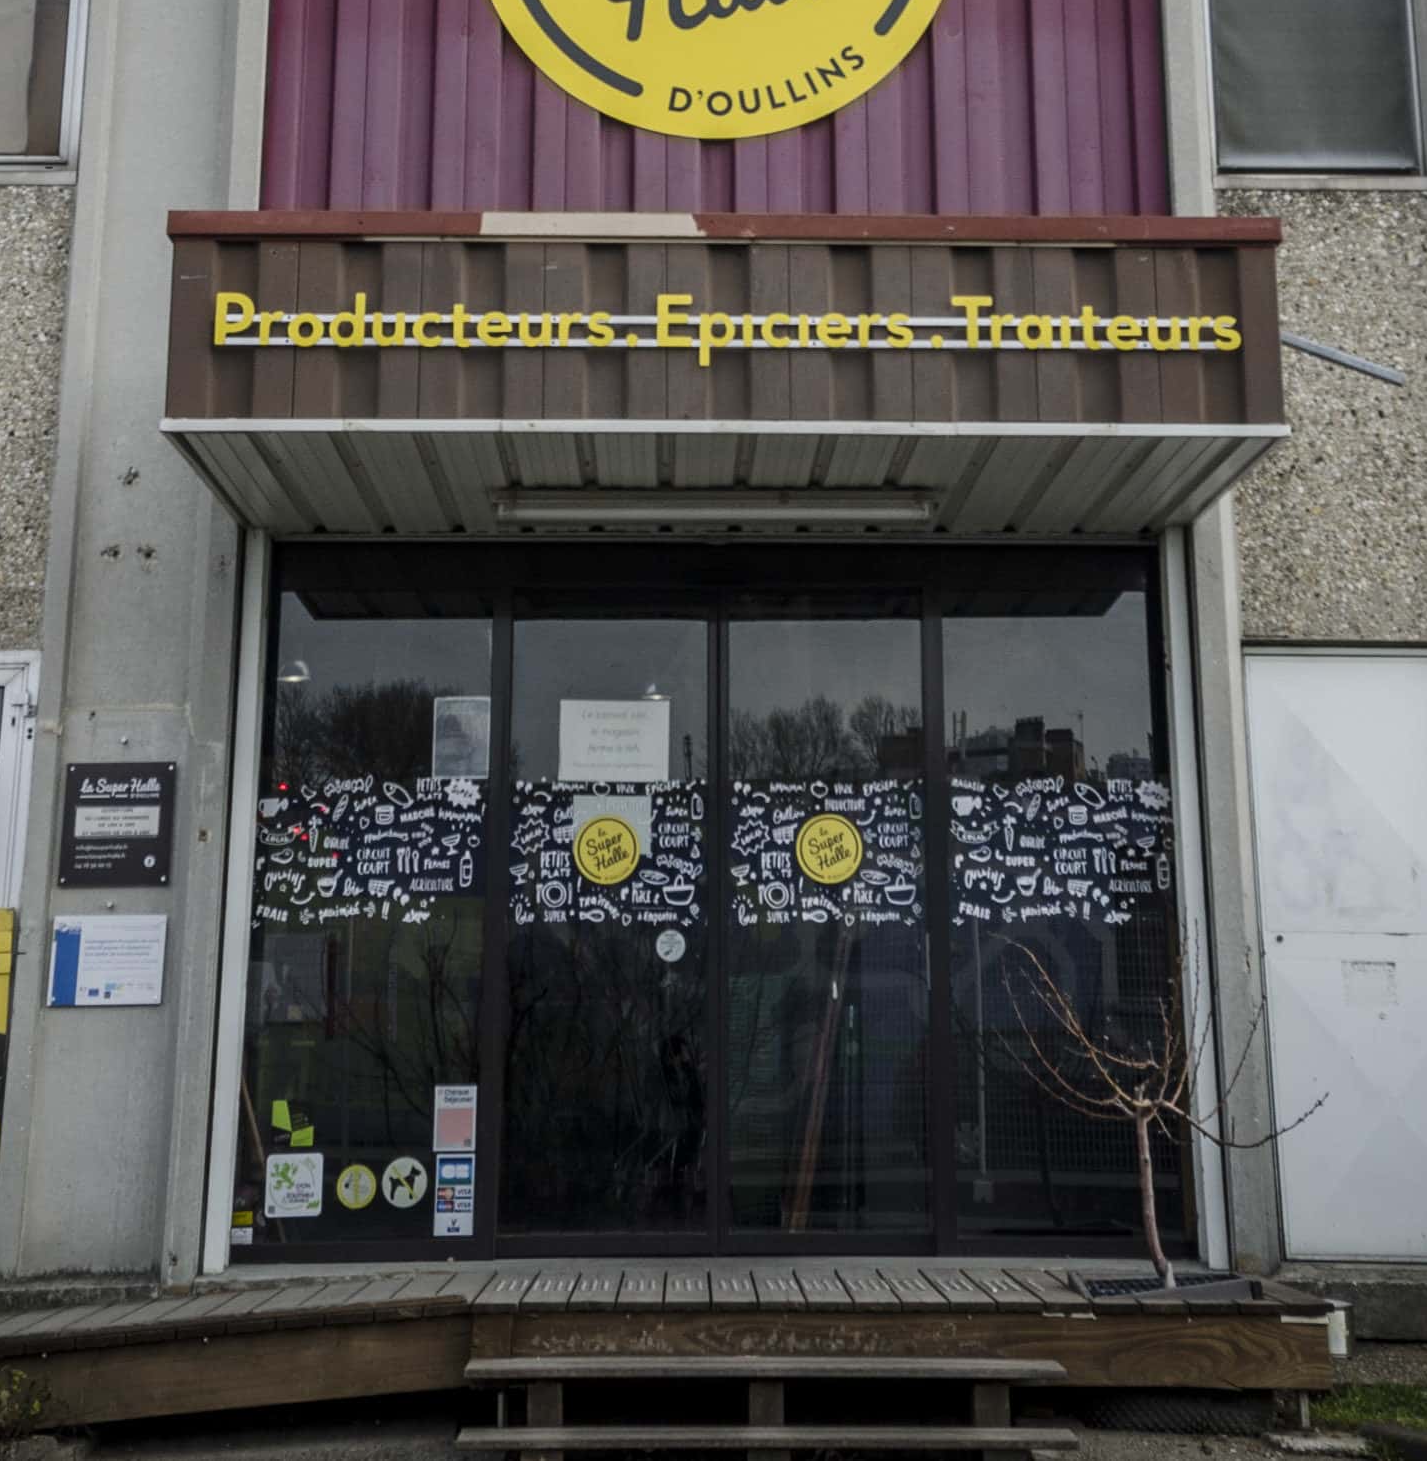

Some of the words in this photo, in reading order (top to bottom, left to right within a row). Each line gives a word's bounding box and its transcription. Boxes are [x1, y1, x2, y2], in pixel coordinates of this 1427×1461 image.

[668, 45, 866, 117] D'OULLINS
[95, 778, 129, 798] Super
[130, 777, 161, 793] Halle
[585, 832, 623, 857] Super
[807, 831, 845, 856] Super
[592, 844, 630, 873] Halle
[815, 843, 853, 871] Halle
